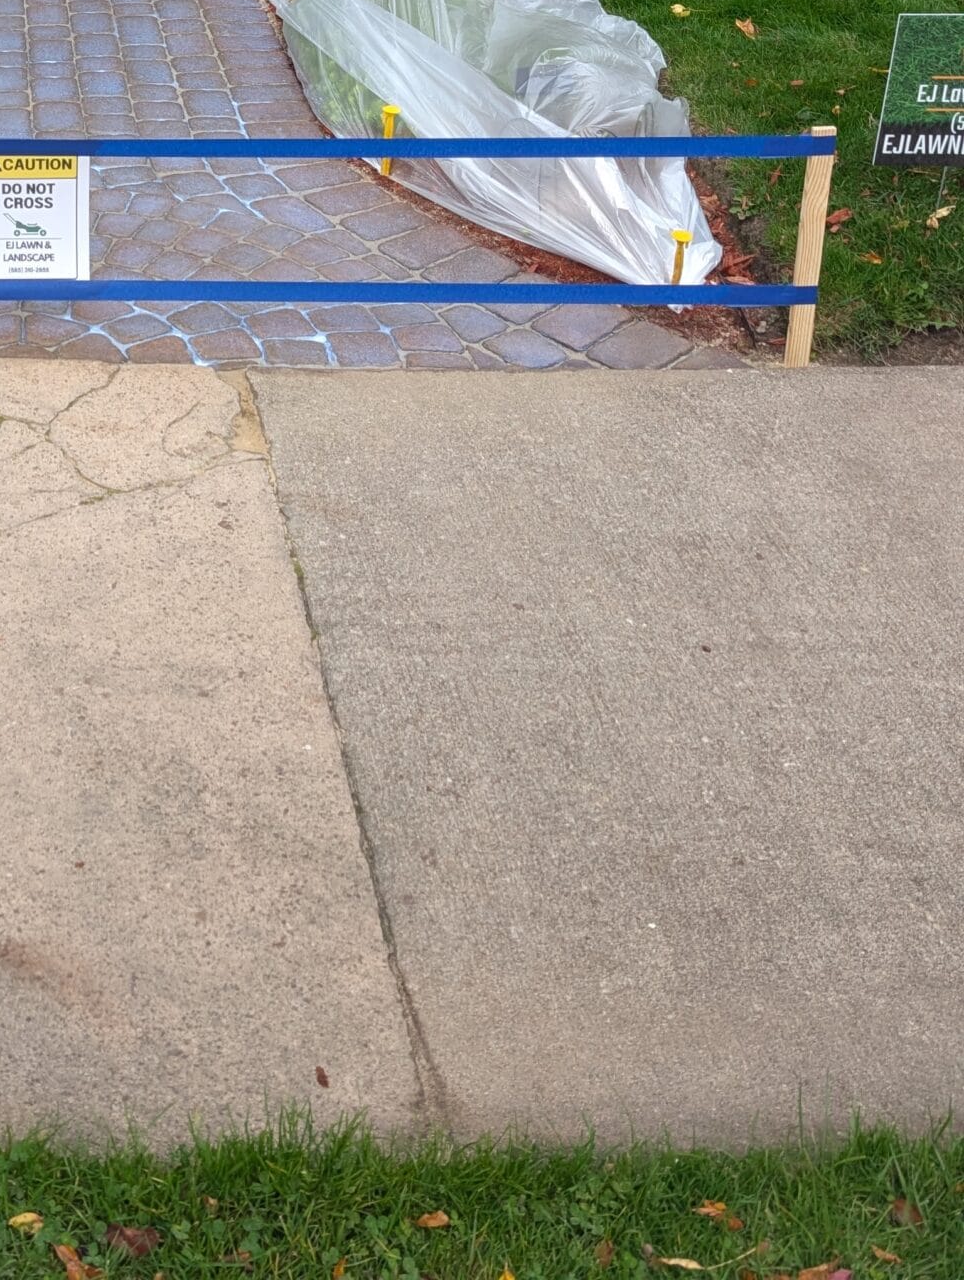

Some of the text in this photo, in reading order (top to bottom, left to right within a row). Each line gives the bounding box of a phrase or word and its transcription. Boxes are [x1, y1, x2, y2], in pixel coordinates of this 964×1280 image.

[916, 84, 939, 103] EJ
[2, 158, 72, 171] CAUTION
[2, 183, 55, 195] DO NOT
[3, 197, 54, 209] CROSS
[5, 241, 52, 249] EJ LAWN &
[3, 253, 55, 262] LANDSCAPE
